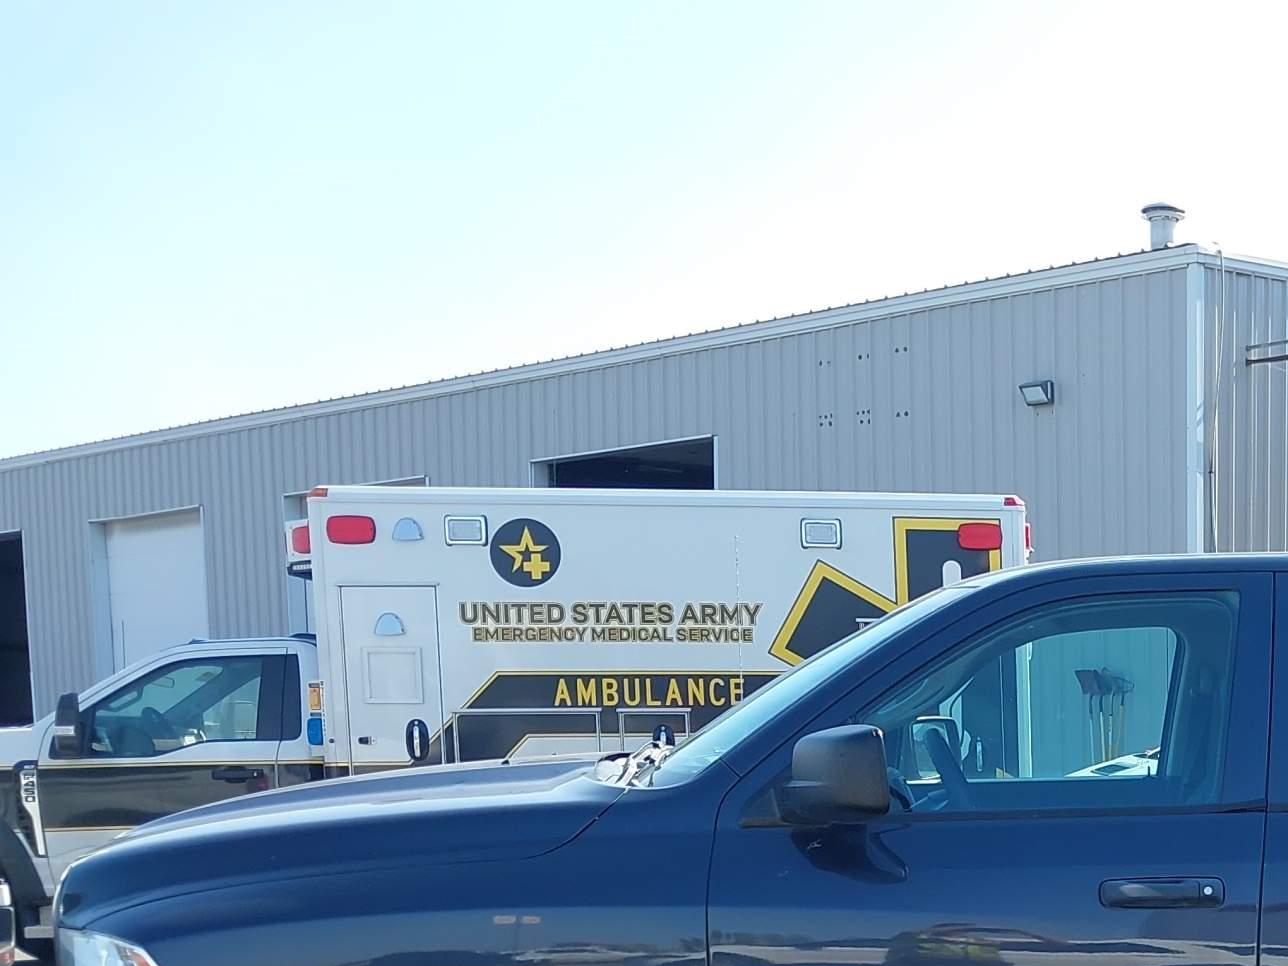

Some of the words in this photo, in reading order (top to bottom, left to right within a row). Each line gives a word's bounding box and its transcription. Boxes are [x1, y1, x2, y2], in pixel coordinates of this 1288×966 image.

[459, 600, 566, 625] UNITED
[571, 600, 675, 626] STATES
[681, 601, 764, 626] ARMY
[472, 626, 588, 642] EMERGENCY
[591, 626, 674, 643] MEDICAL
[676, 627, 754, 643] SERVICE
[553, 677, 744, 706] AMBULANCE
